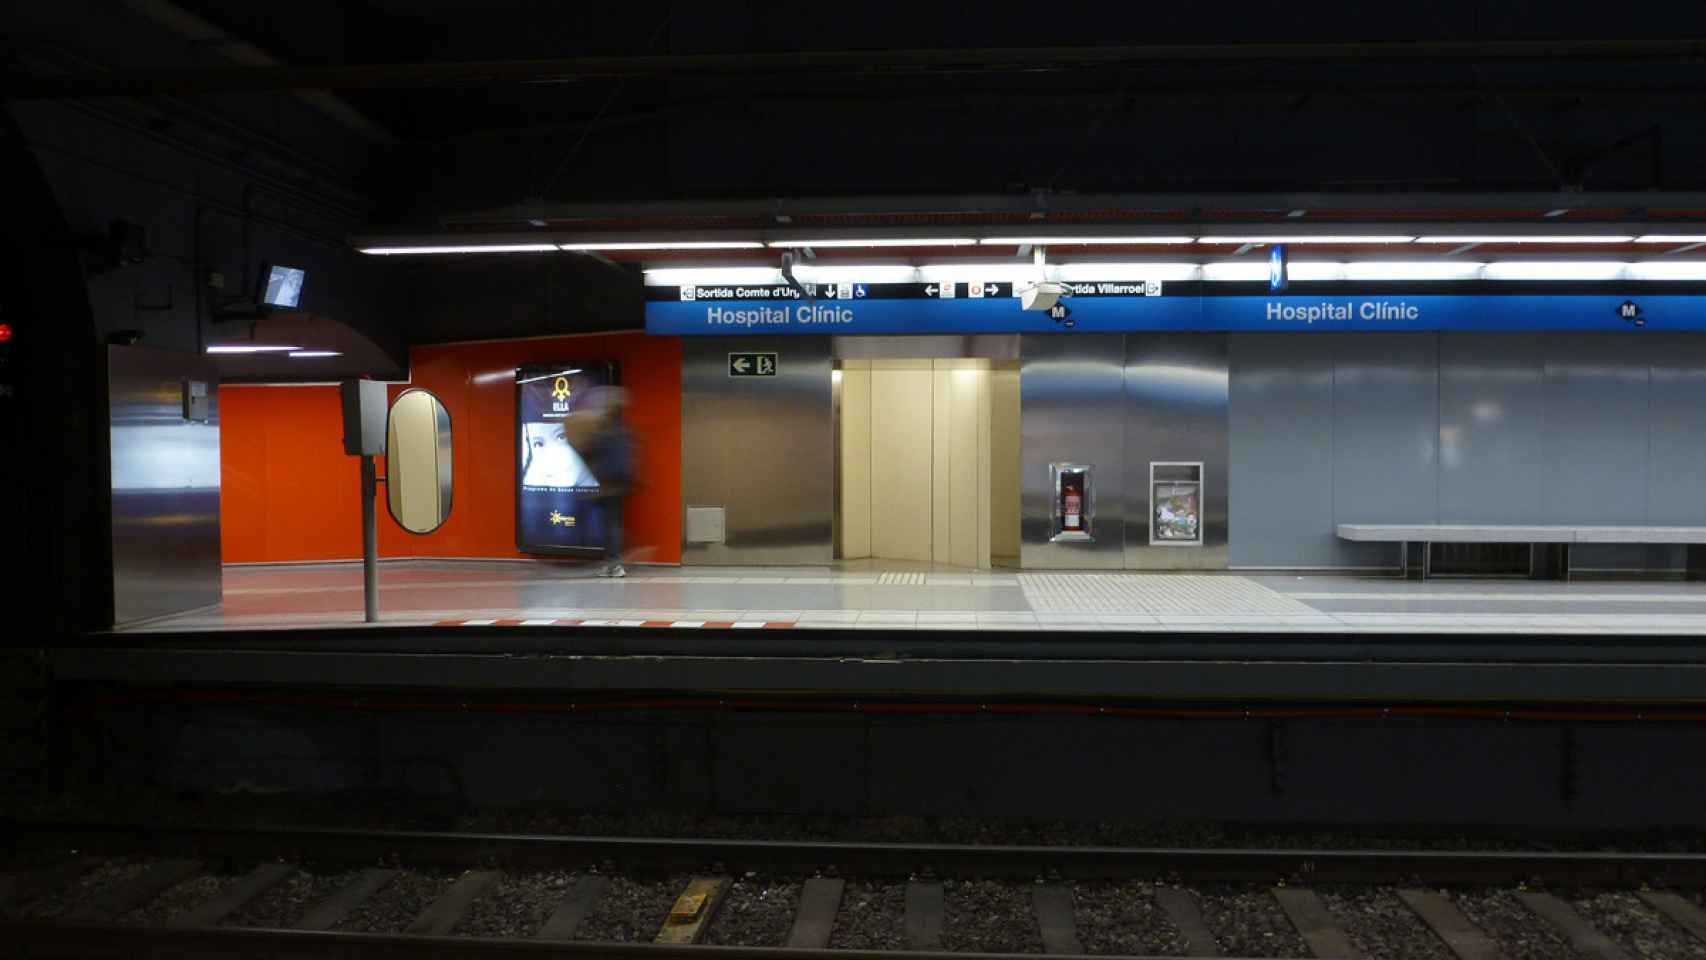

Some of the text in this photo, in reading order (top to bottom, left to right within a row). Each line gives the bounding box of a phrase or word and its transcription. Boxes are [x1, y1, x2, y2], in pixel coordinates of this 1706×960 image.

[697, 287, 733, 298] Sortida
[735, 287, 771, 298] Comte
[1071, 283, 1144, 294] rtida Villarroel
[707, 305, 854, 328] Hospital Clínic
[1051, 305, 1065, 318] M
[1266, 302, 1419, 324] Hospital Clínic
[1622, 304, 1636, 317] M
